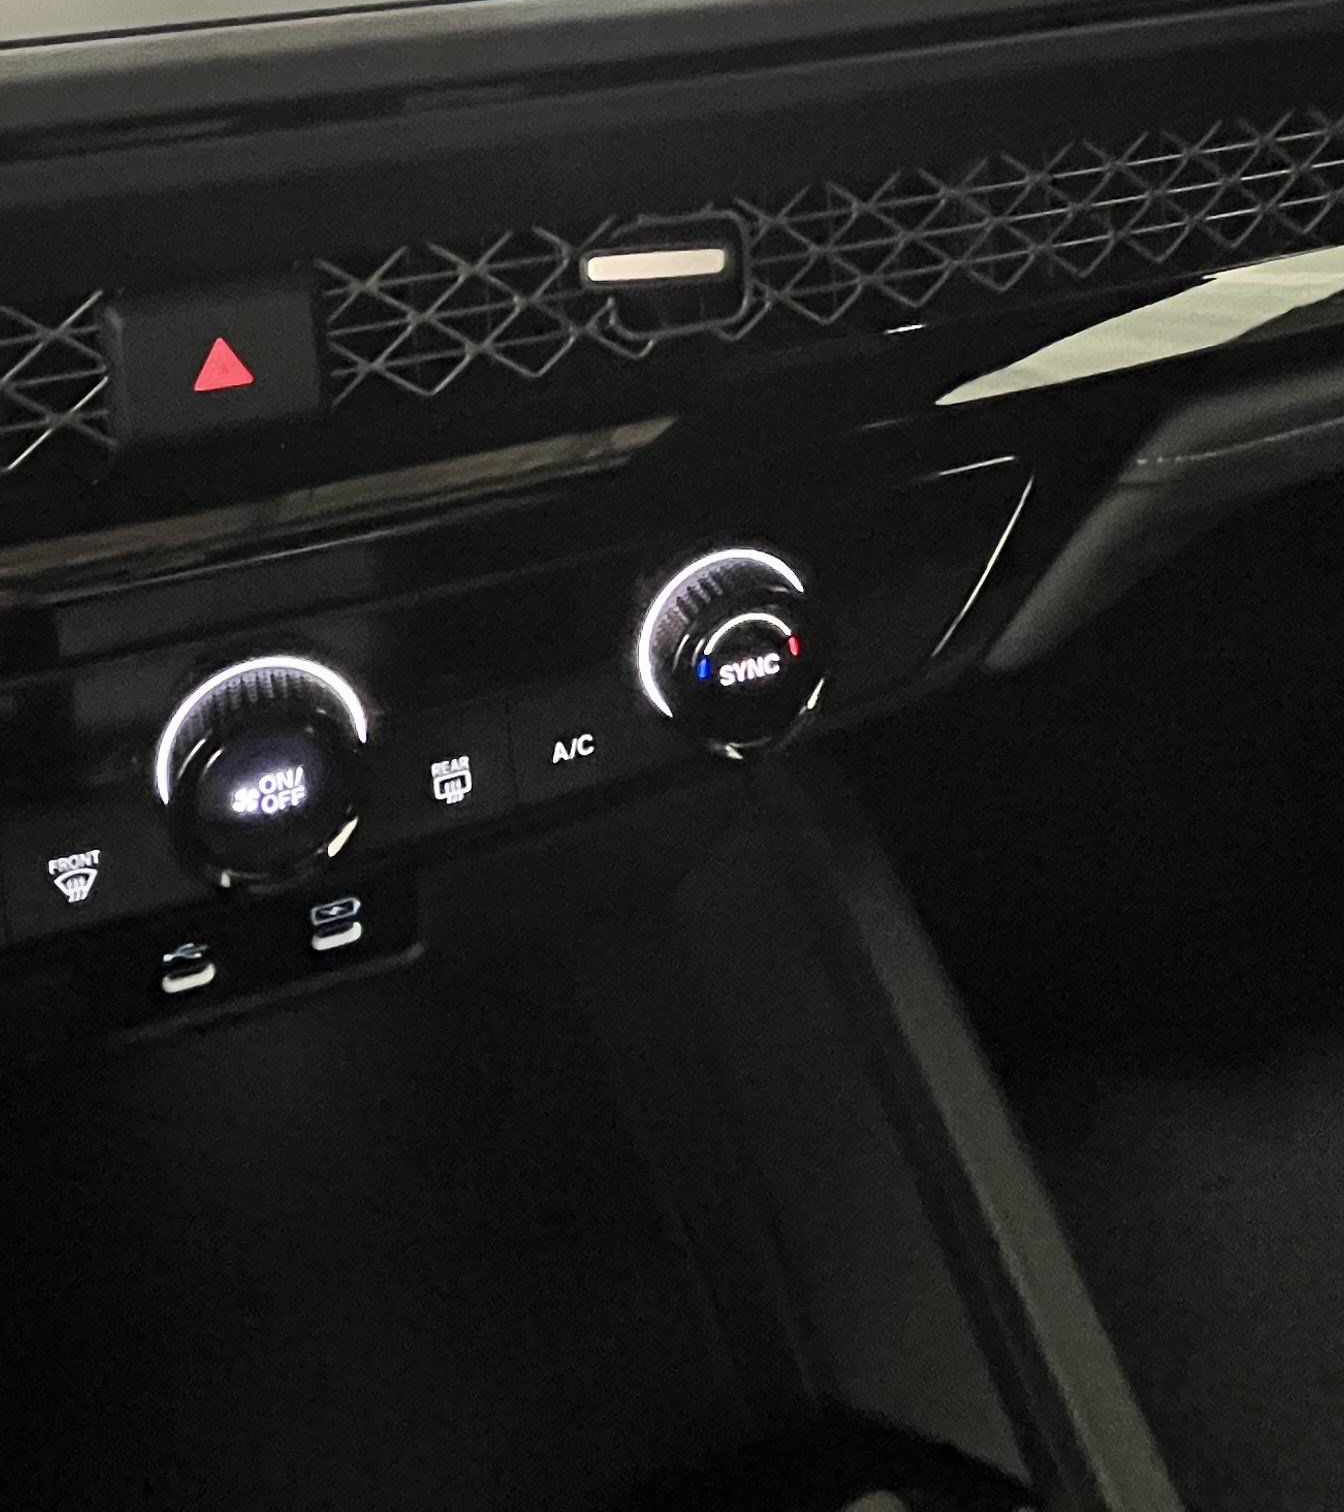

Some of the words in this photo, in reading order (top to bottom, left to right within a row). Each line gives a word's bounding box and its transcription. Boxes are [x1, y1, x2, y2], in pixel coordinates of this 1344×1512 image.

[719, 653, 782, 687] SYNC
[552, 733, 595, 764] A/C
[258, 765, 304, 794] ON/
[431, 756, 471, 778] REAR
[260, 785, 307, 814] OFF
[48, 849, 101, 875] FRONT
